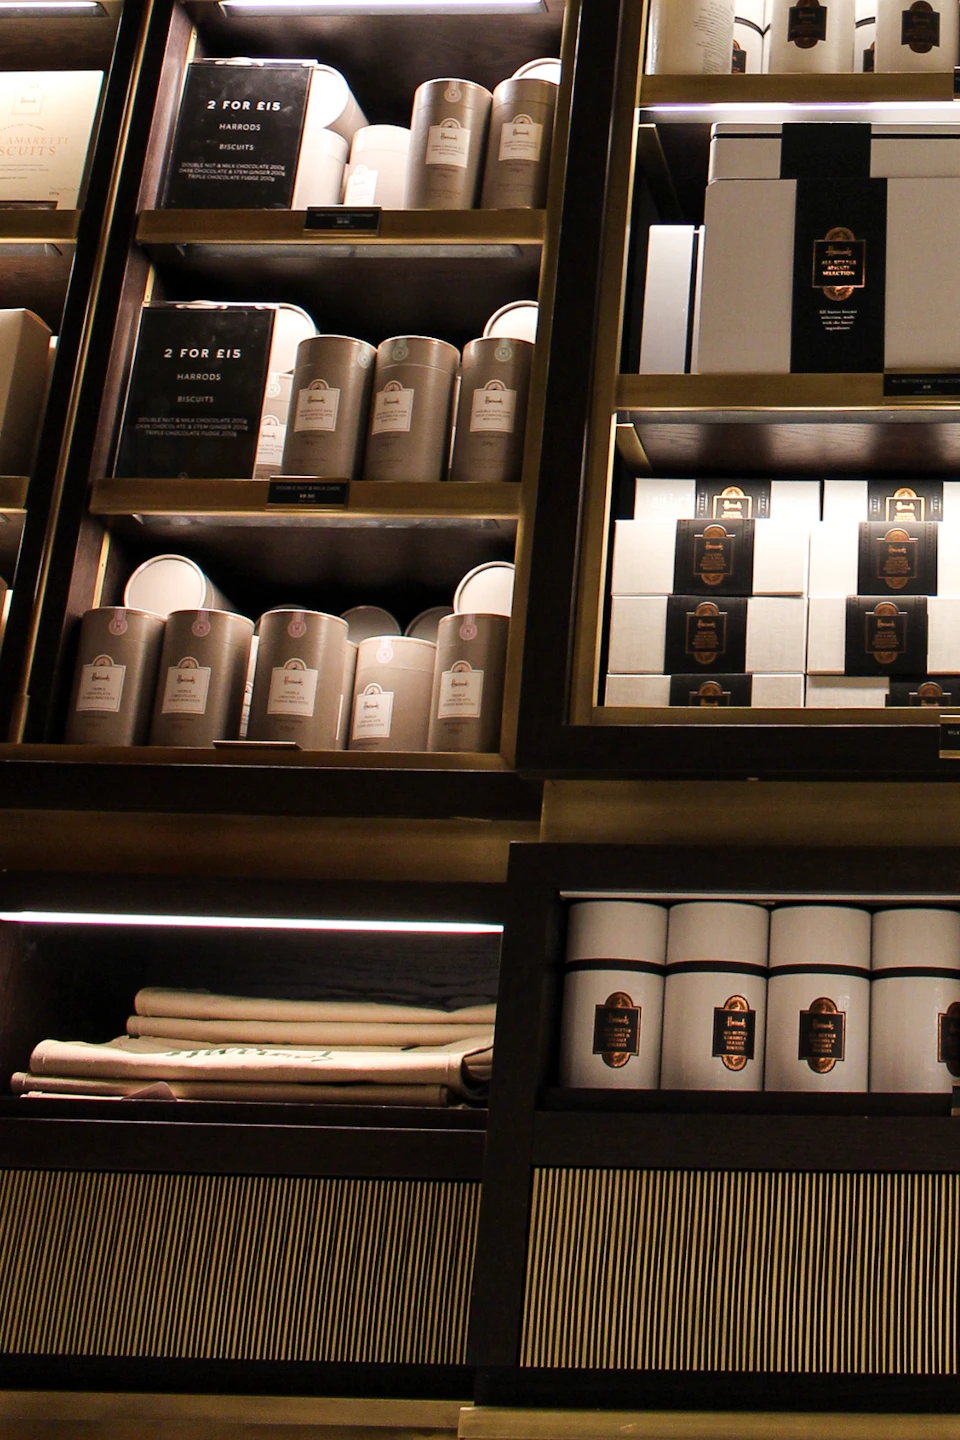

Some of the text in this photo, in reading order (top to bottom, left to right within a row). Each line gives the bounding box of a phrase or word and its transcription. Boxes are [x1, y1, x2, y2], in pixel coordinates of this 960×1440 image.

[207, 100, 281, 111] 2 FOR £15
[219, 123, 261, 131] HARRODS
[8, 136, 69, 145] AMARETTI
[219, 143, 254, 151] BISCUITS
[164, 348, 241, 359] 2 FOR £15
[177, 373, 221, 381] HARRODS
[178, 395, 214, 403] BISCUITS
